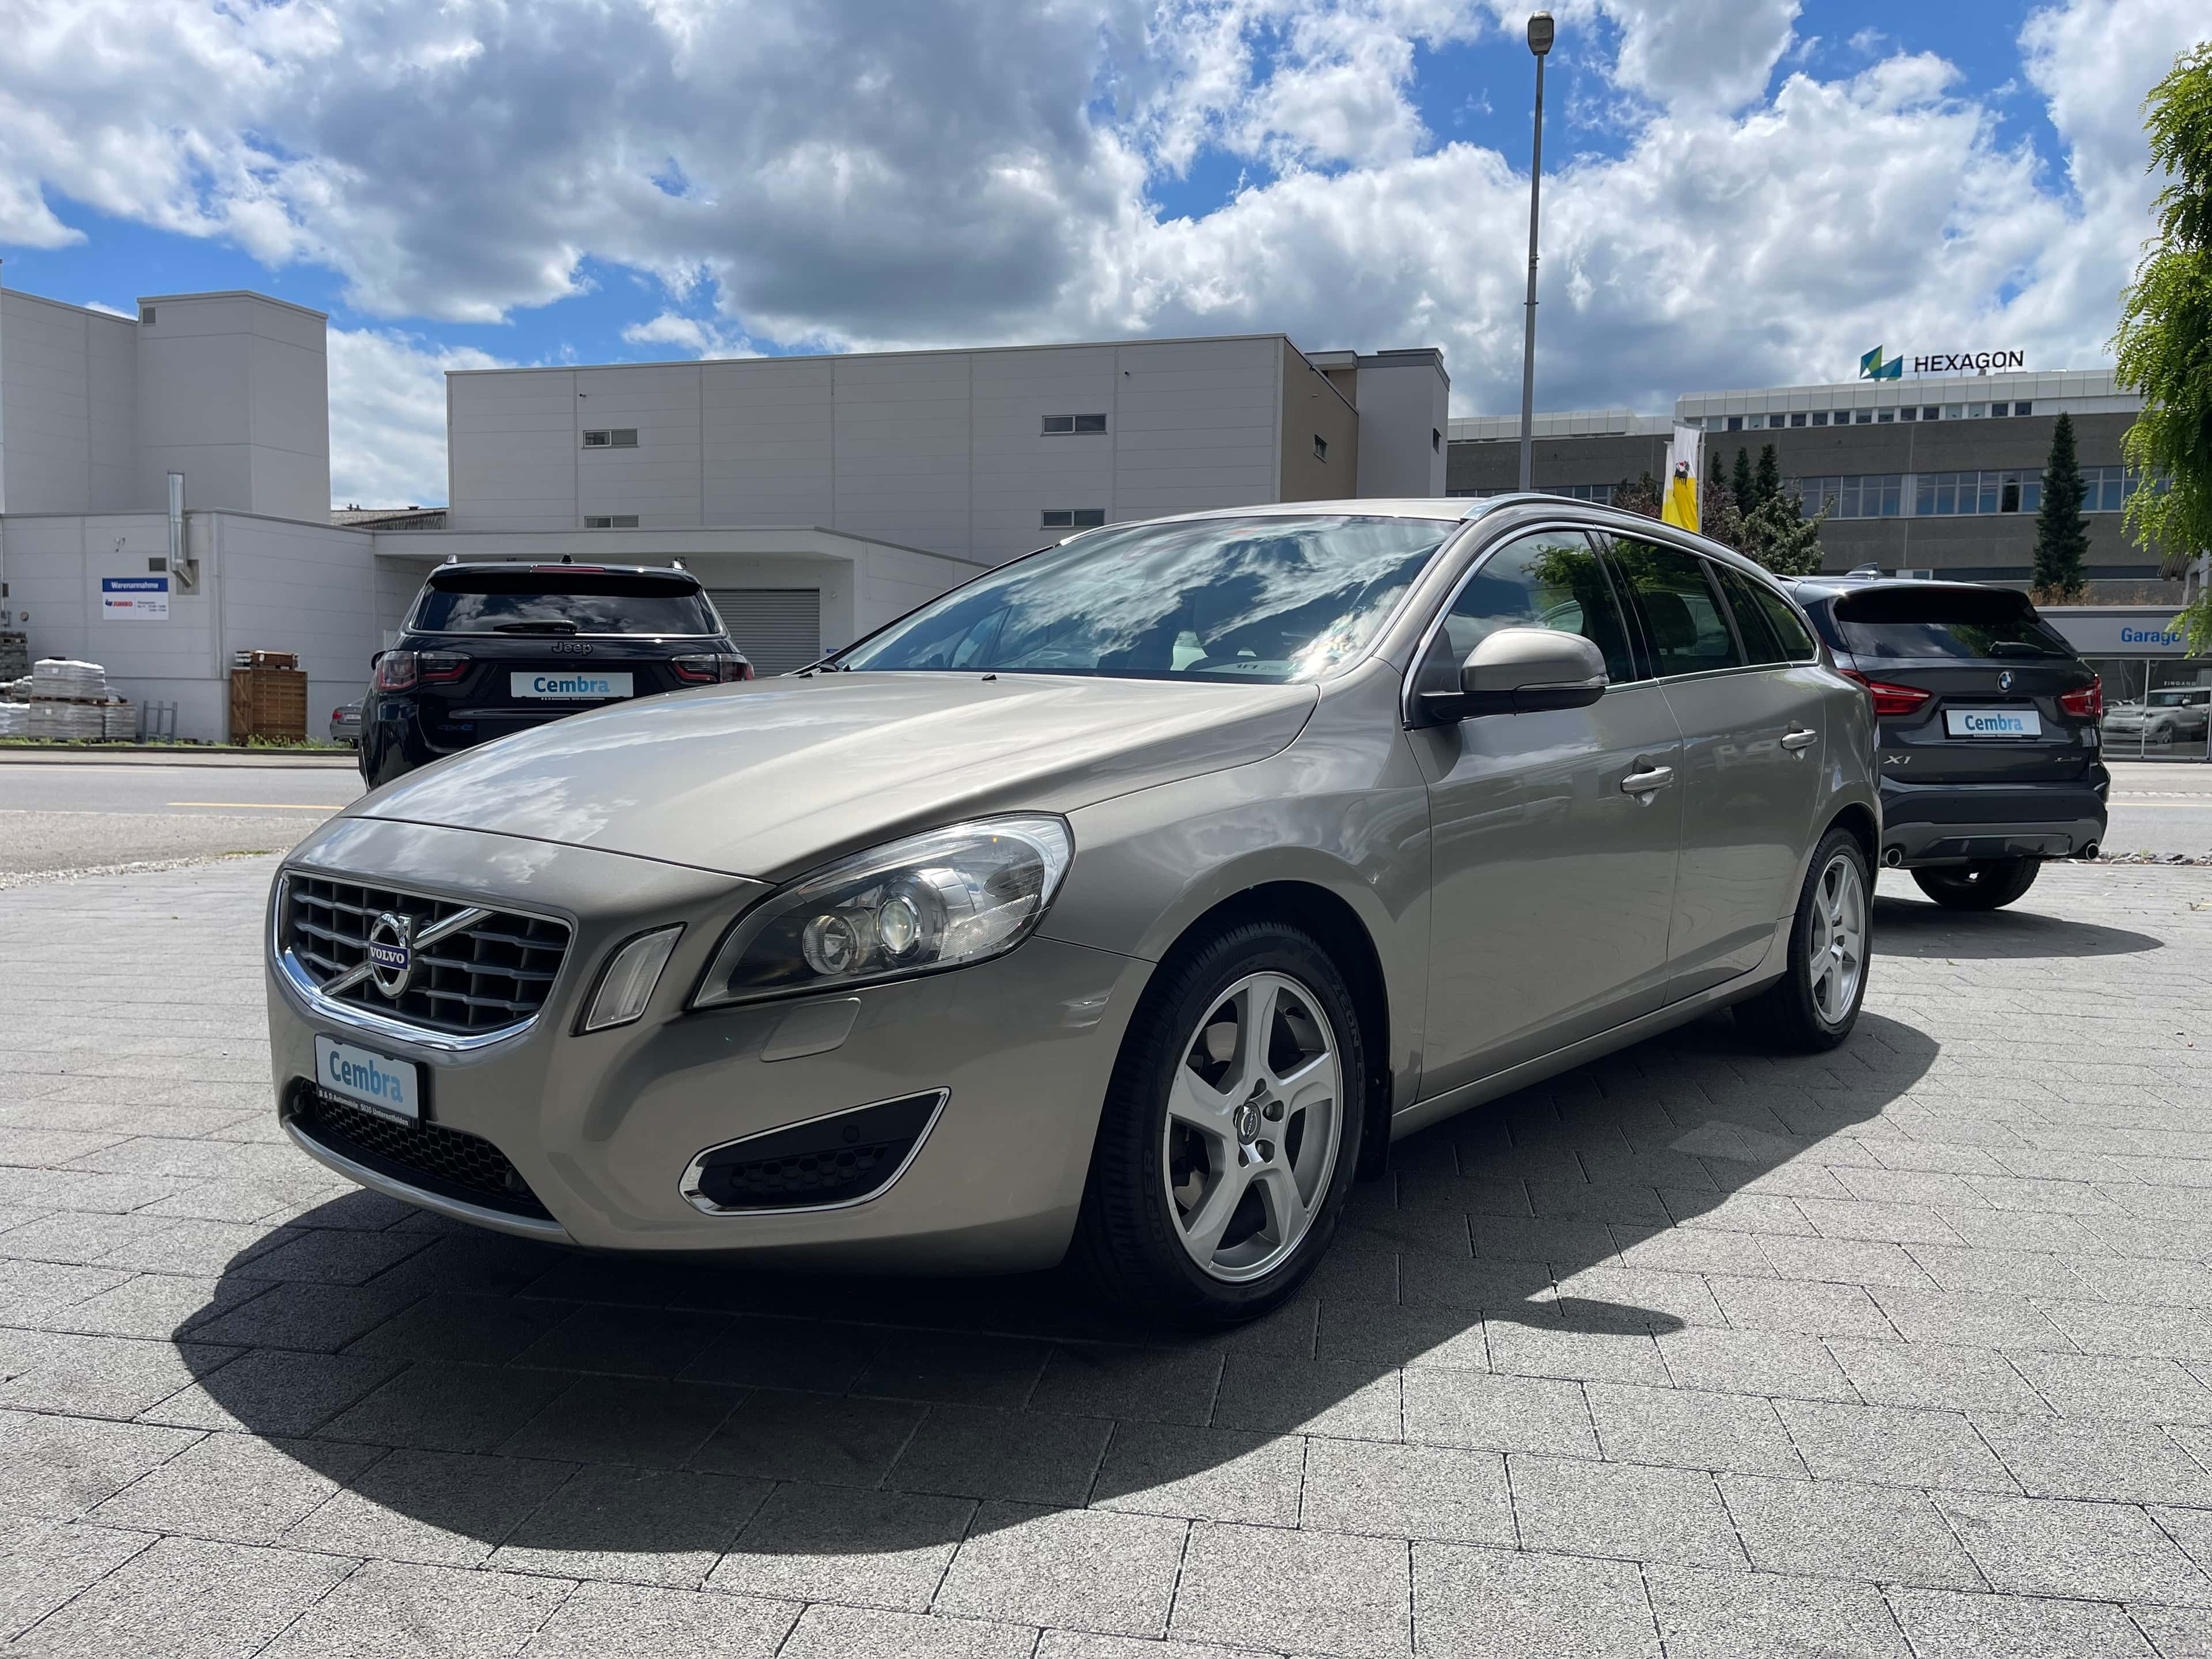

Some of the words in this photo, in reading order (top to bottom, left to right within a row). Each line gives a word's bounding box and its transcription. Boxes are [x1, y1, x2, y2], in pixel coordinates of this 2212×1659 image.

[1914, 350, 2024, 372] HEXAGON
[111, 581, 159, 589] Warenannahme
[551, 642, 593, 656] Jeep
[533, 675, 610, 693] Cembra
[1964, 714, 2024, 731] Cembra
[1883, 755, 1912, 764] X1
[369, 946, 405, 964] VOLVO
[329, 1050, 404, 1103] Cembra
[333, 1094, 359, 1109] Automobile
[360, 1103, 372, 1114] 5035
